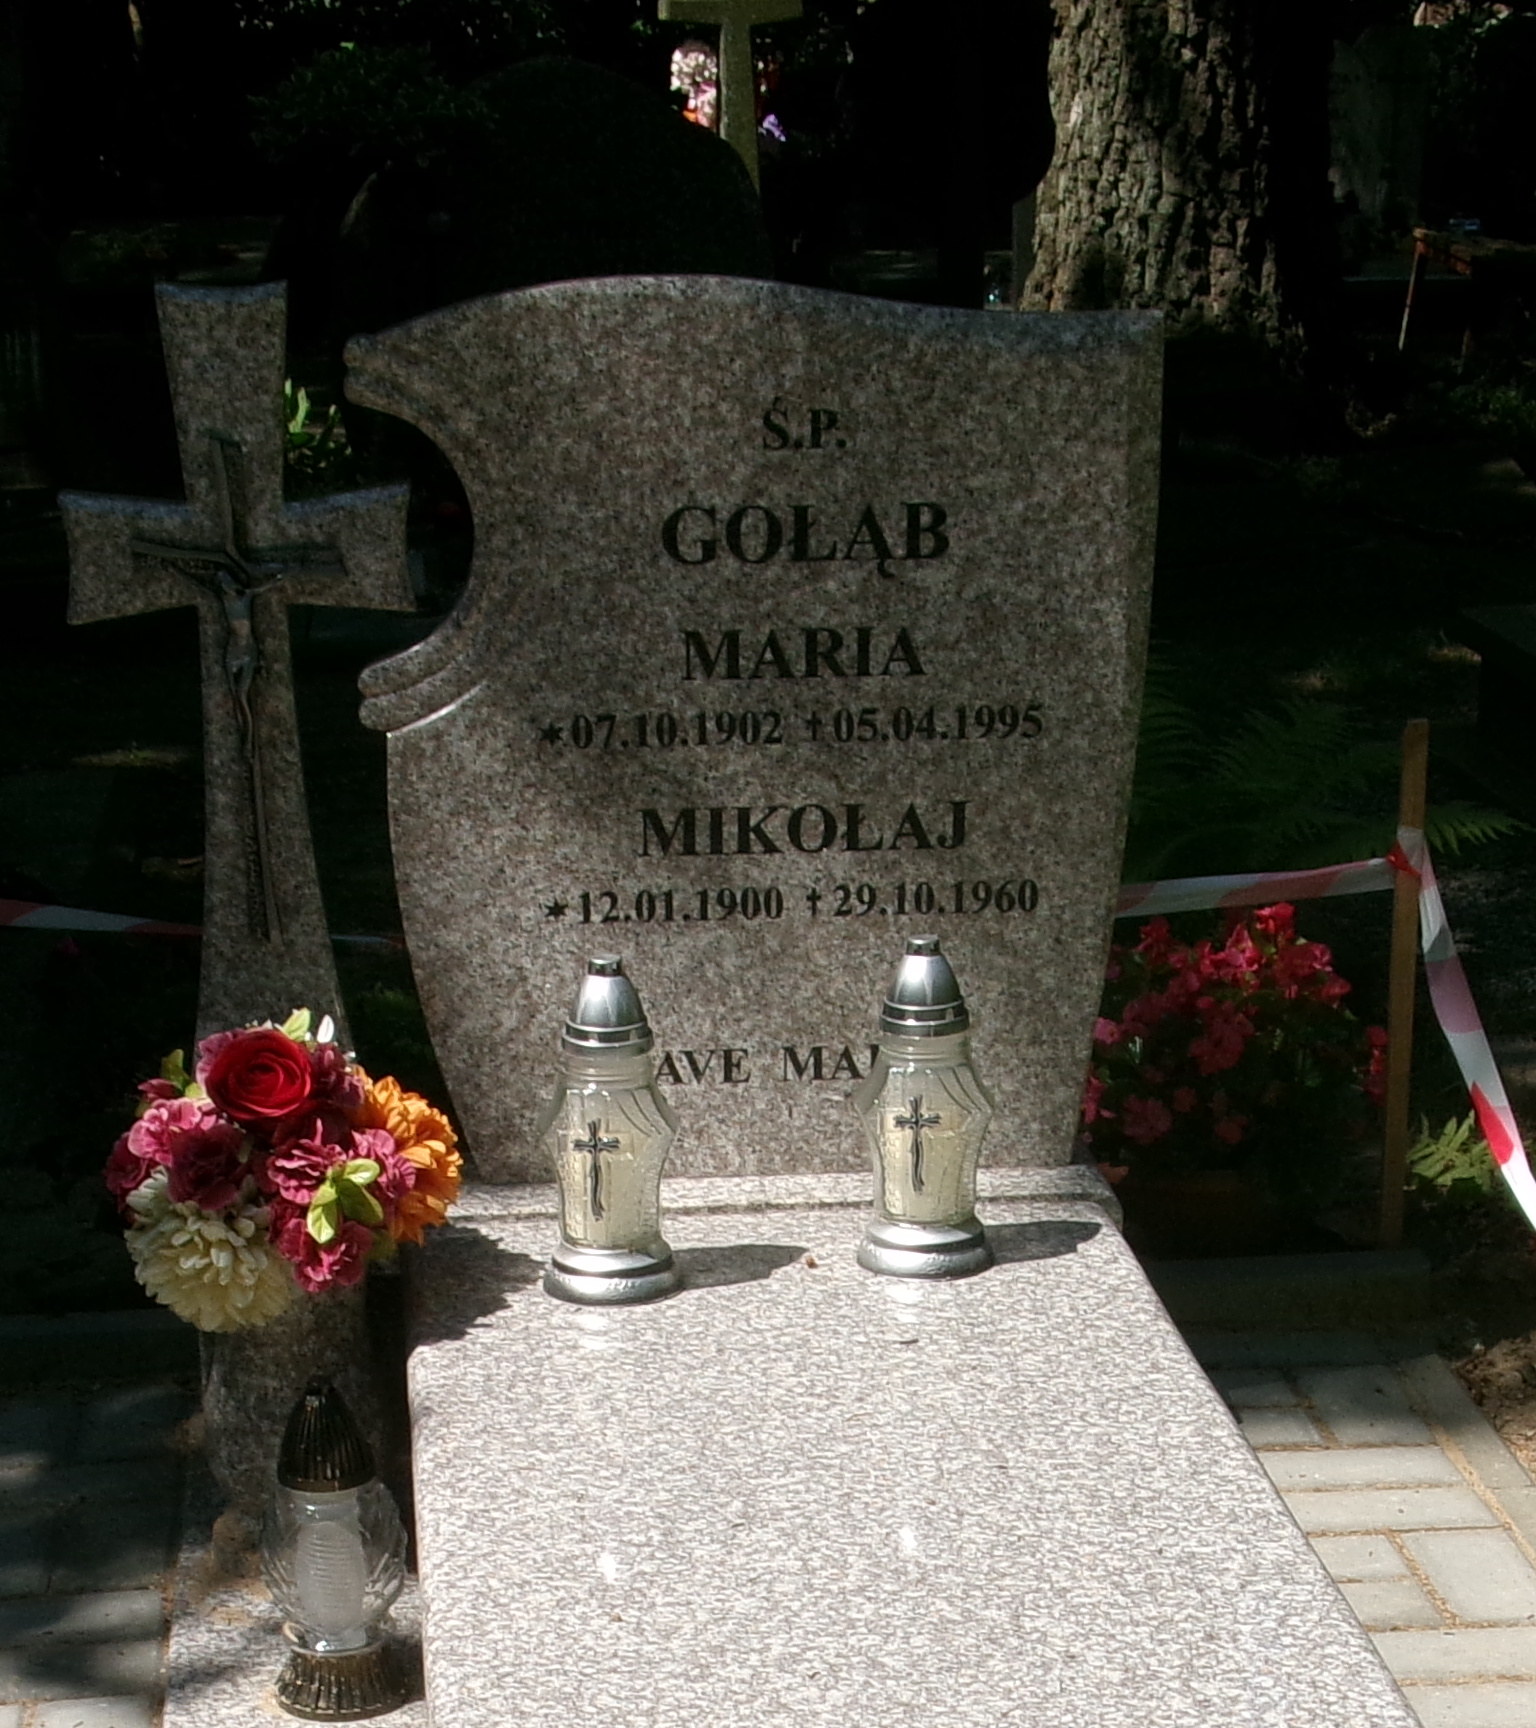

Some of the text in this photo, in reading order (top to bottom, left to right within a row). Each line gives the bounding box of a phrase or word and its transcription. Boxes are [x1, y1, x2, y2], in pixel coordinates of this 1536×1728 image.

[762, 396, 848, 449] Ś.P.
[662, 501, 951, 578] GOŁĄB
[682, 626, 928, 681] MARIA
[637, 800, 970, 857] MIKOŁAJ
[655, 1043, 880, 1085] AVE MA
